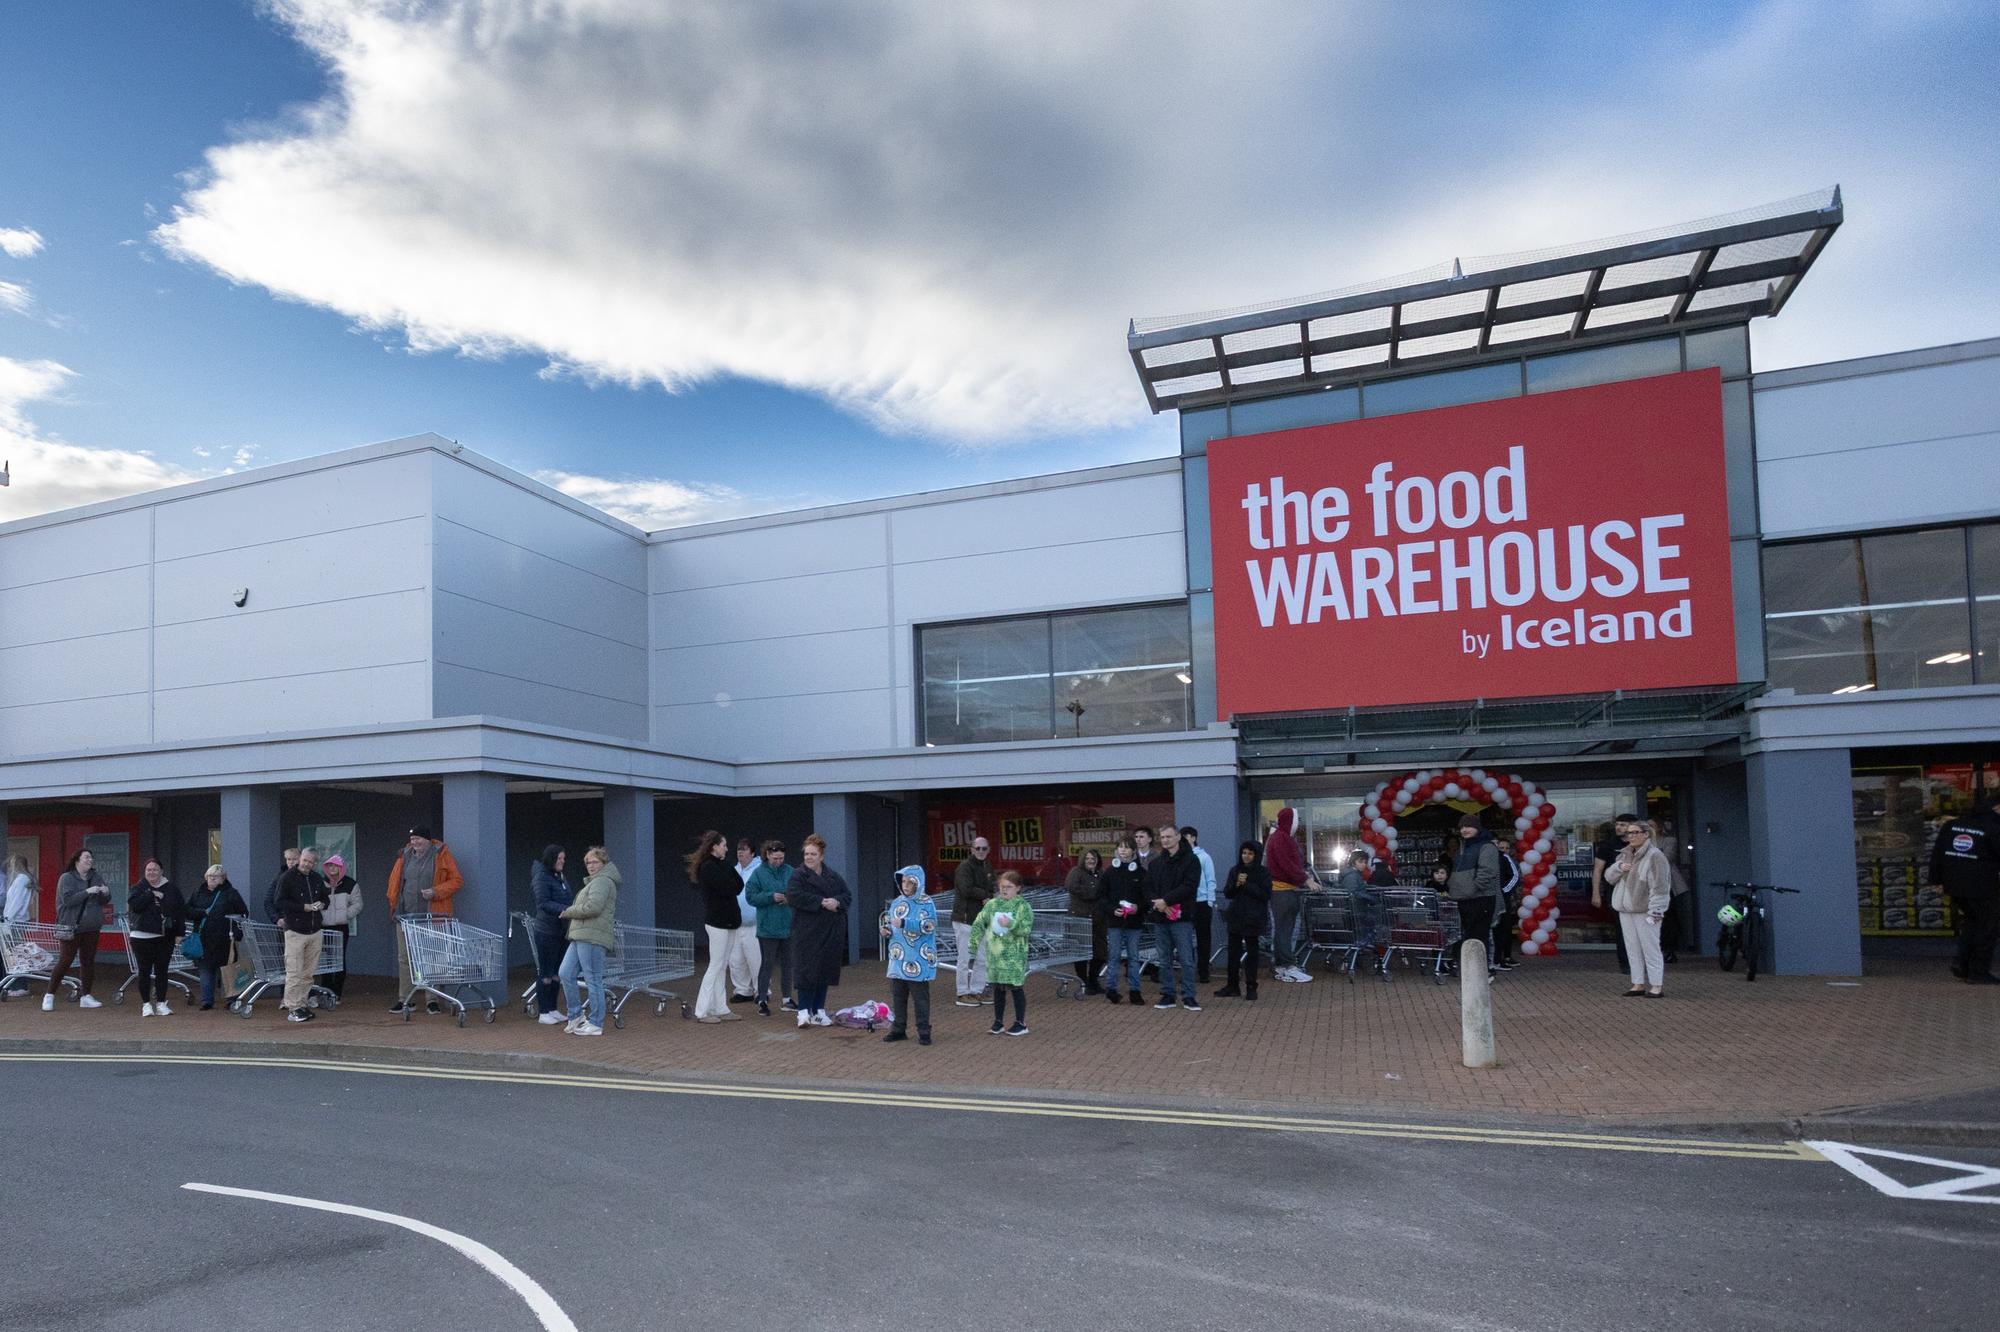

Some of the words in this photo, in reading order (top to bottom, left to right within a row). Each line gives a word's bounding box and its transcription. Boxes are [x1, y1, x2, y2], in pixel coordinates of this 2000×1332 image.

[1241, 476, 1350, 550] the
[1365, 445, 1528, 537] food
[1245, 513, 1690, 627] WAREHOUSE
[1462, 629, 1491, 659] by
[1502, 599, 1693, 651] Iceland
[943, 820, 977, 846] BIG
[1004, 818, 1039, 844] BIG
[1072, 816, 1124, 829] EXCLUSIVE
[1072, 831, 1112, 843] BRANDS
[1000, 846, 1044, 861] VALUE!
[1558, 871, 1593, 879] ENTRAN
